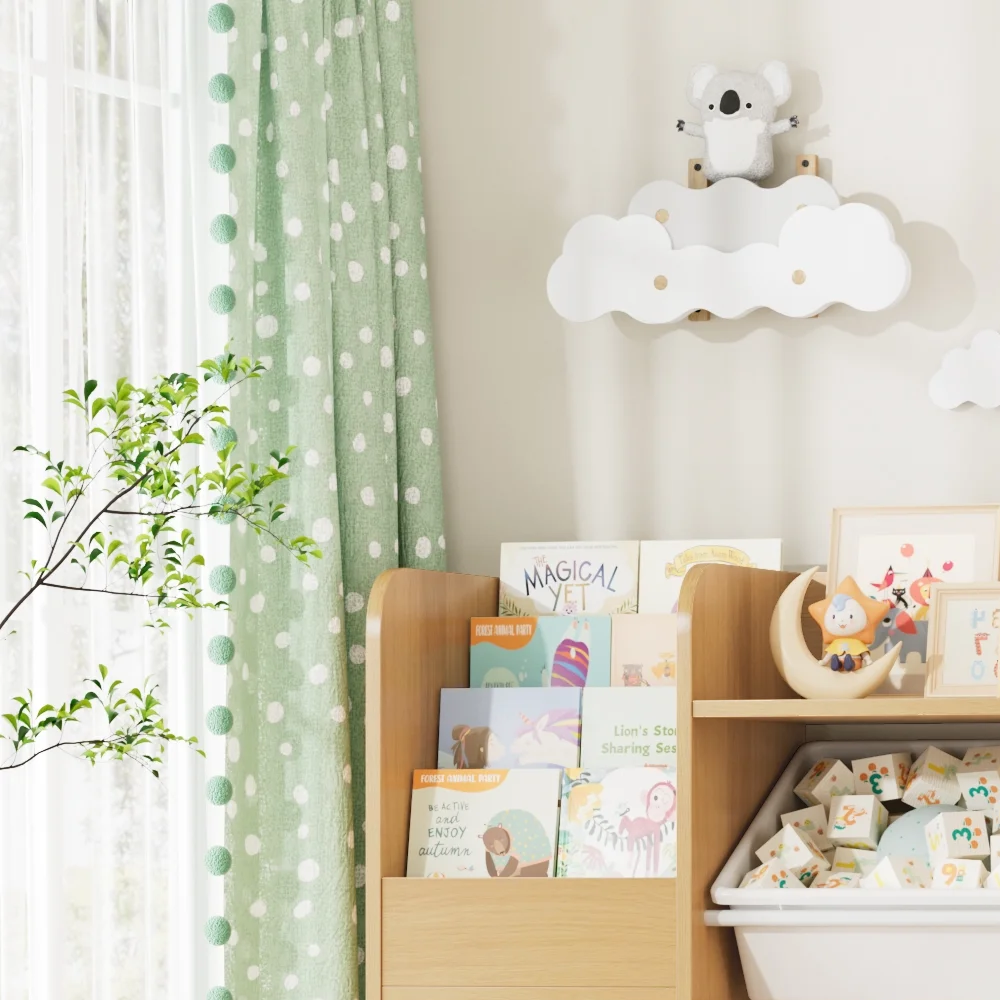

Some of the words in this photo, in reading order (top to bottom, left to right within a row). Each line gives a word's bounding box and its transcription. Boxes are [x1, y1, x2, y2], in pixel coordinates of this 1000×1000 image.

[533, 555, 548, 566] THE
[524, 560, 618, 596] MAGICAL
[548, 583, 590, 612] YET
[476, 624, 493, 636] FOREST
[516, 624, 532, 636] PARTY
[614, 724, 648, 736] Lion's
[601, 742, 650, 757] Sharing
[420, 774, 445, 783] FOREST
[446, 774, 476, 783] ANIMAL
[478, 774, 501, 783] PARTY
[436, 812, 460, 824] and
[428, 826, 466, 840] ENJOY
[418, 841, 473, 858] autumn
